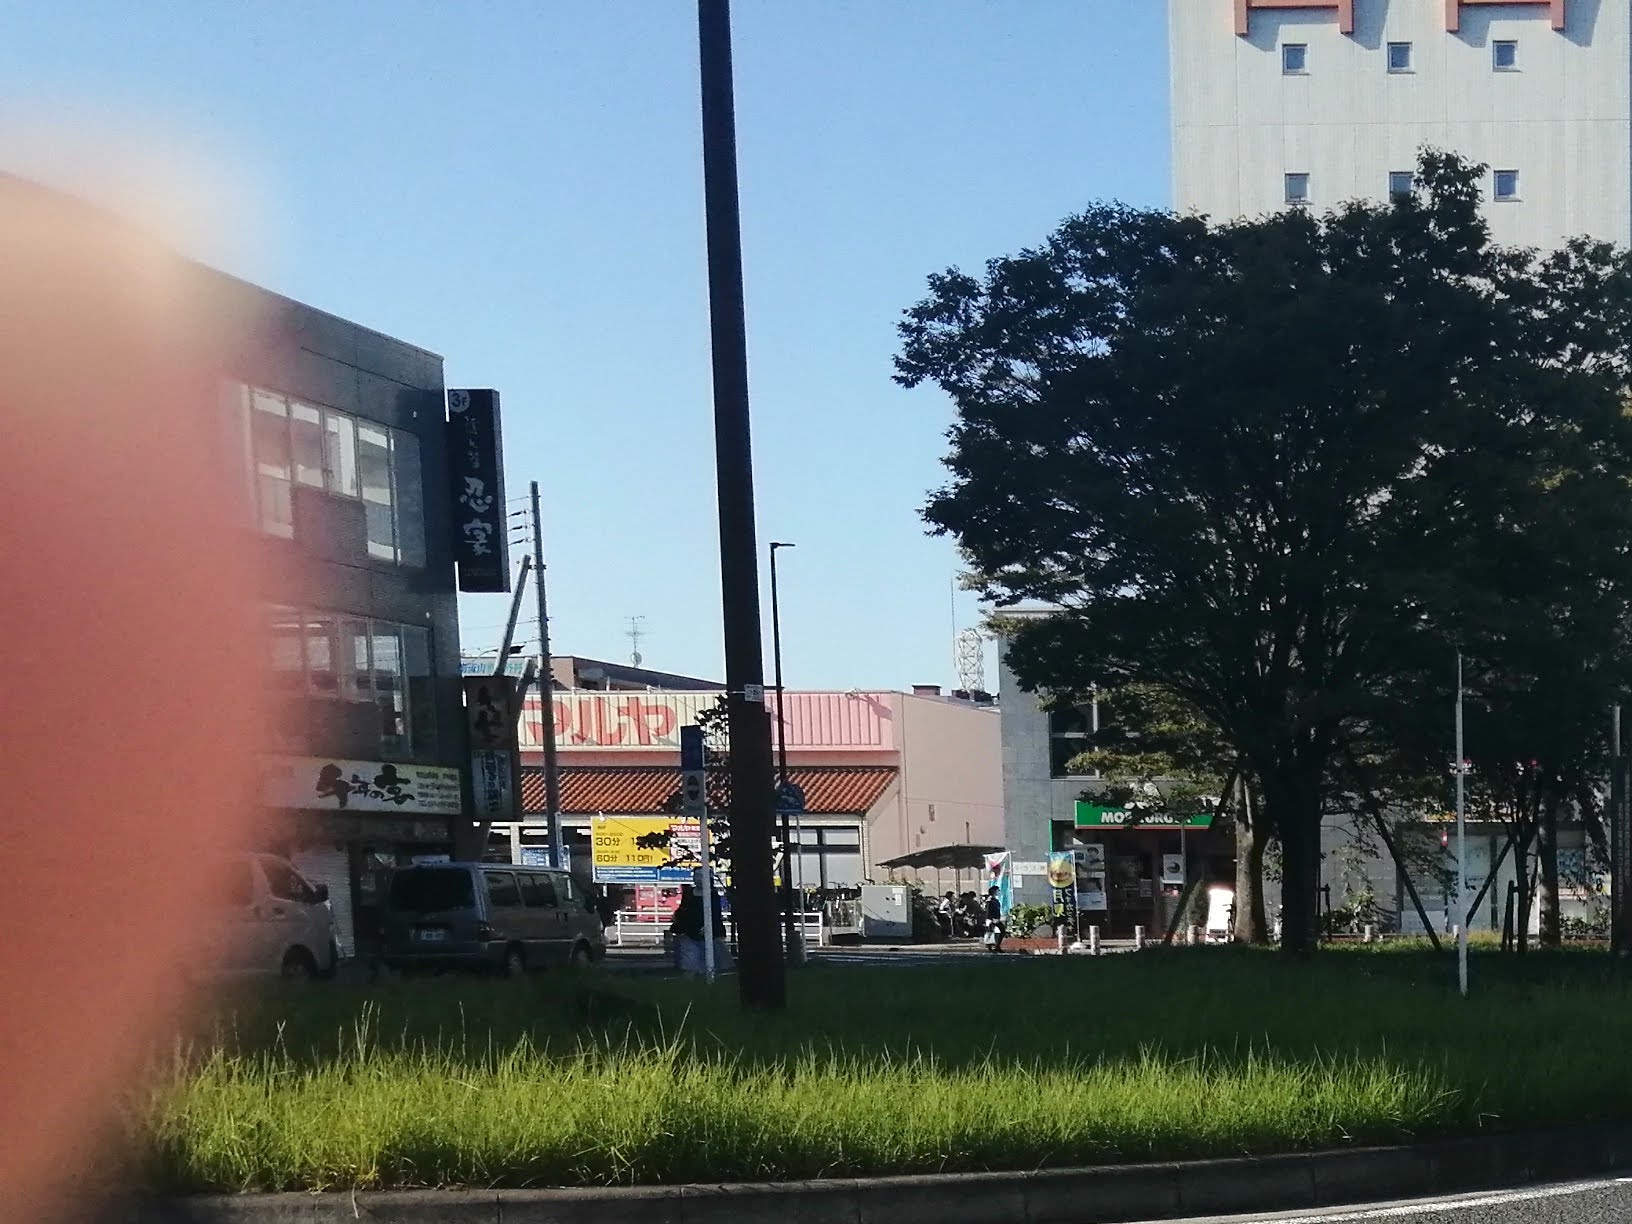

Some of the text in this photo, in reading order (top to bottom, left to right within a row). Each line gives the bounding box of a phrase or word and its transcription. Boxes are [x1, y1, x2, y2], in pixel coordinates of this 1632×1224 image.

[521, 696, 677, 746] マルヤ
[595, 837, 621, 846] 30分
[596, 854, 618, 862] 60分
